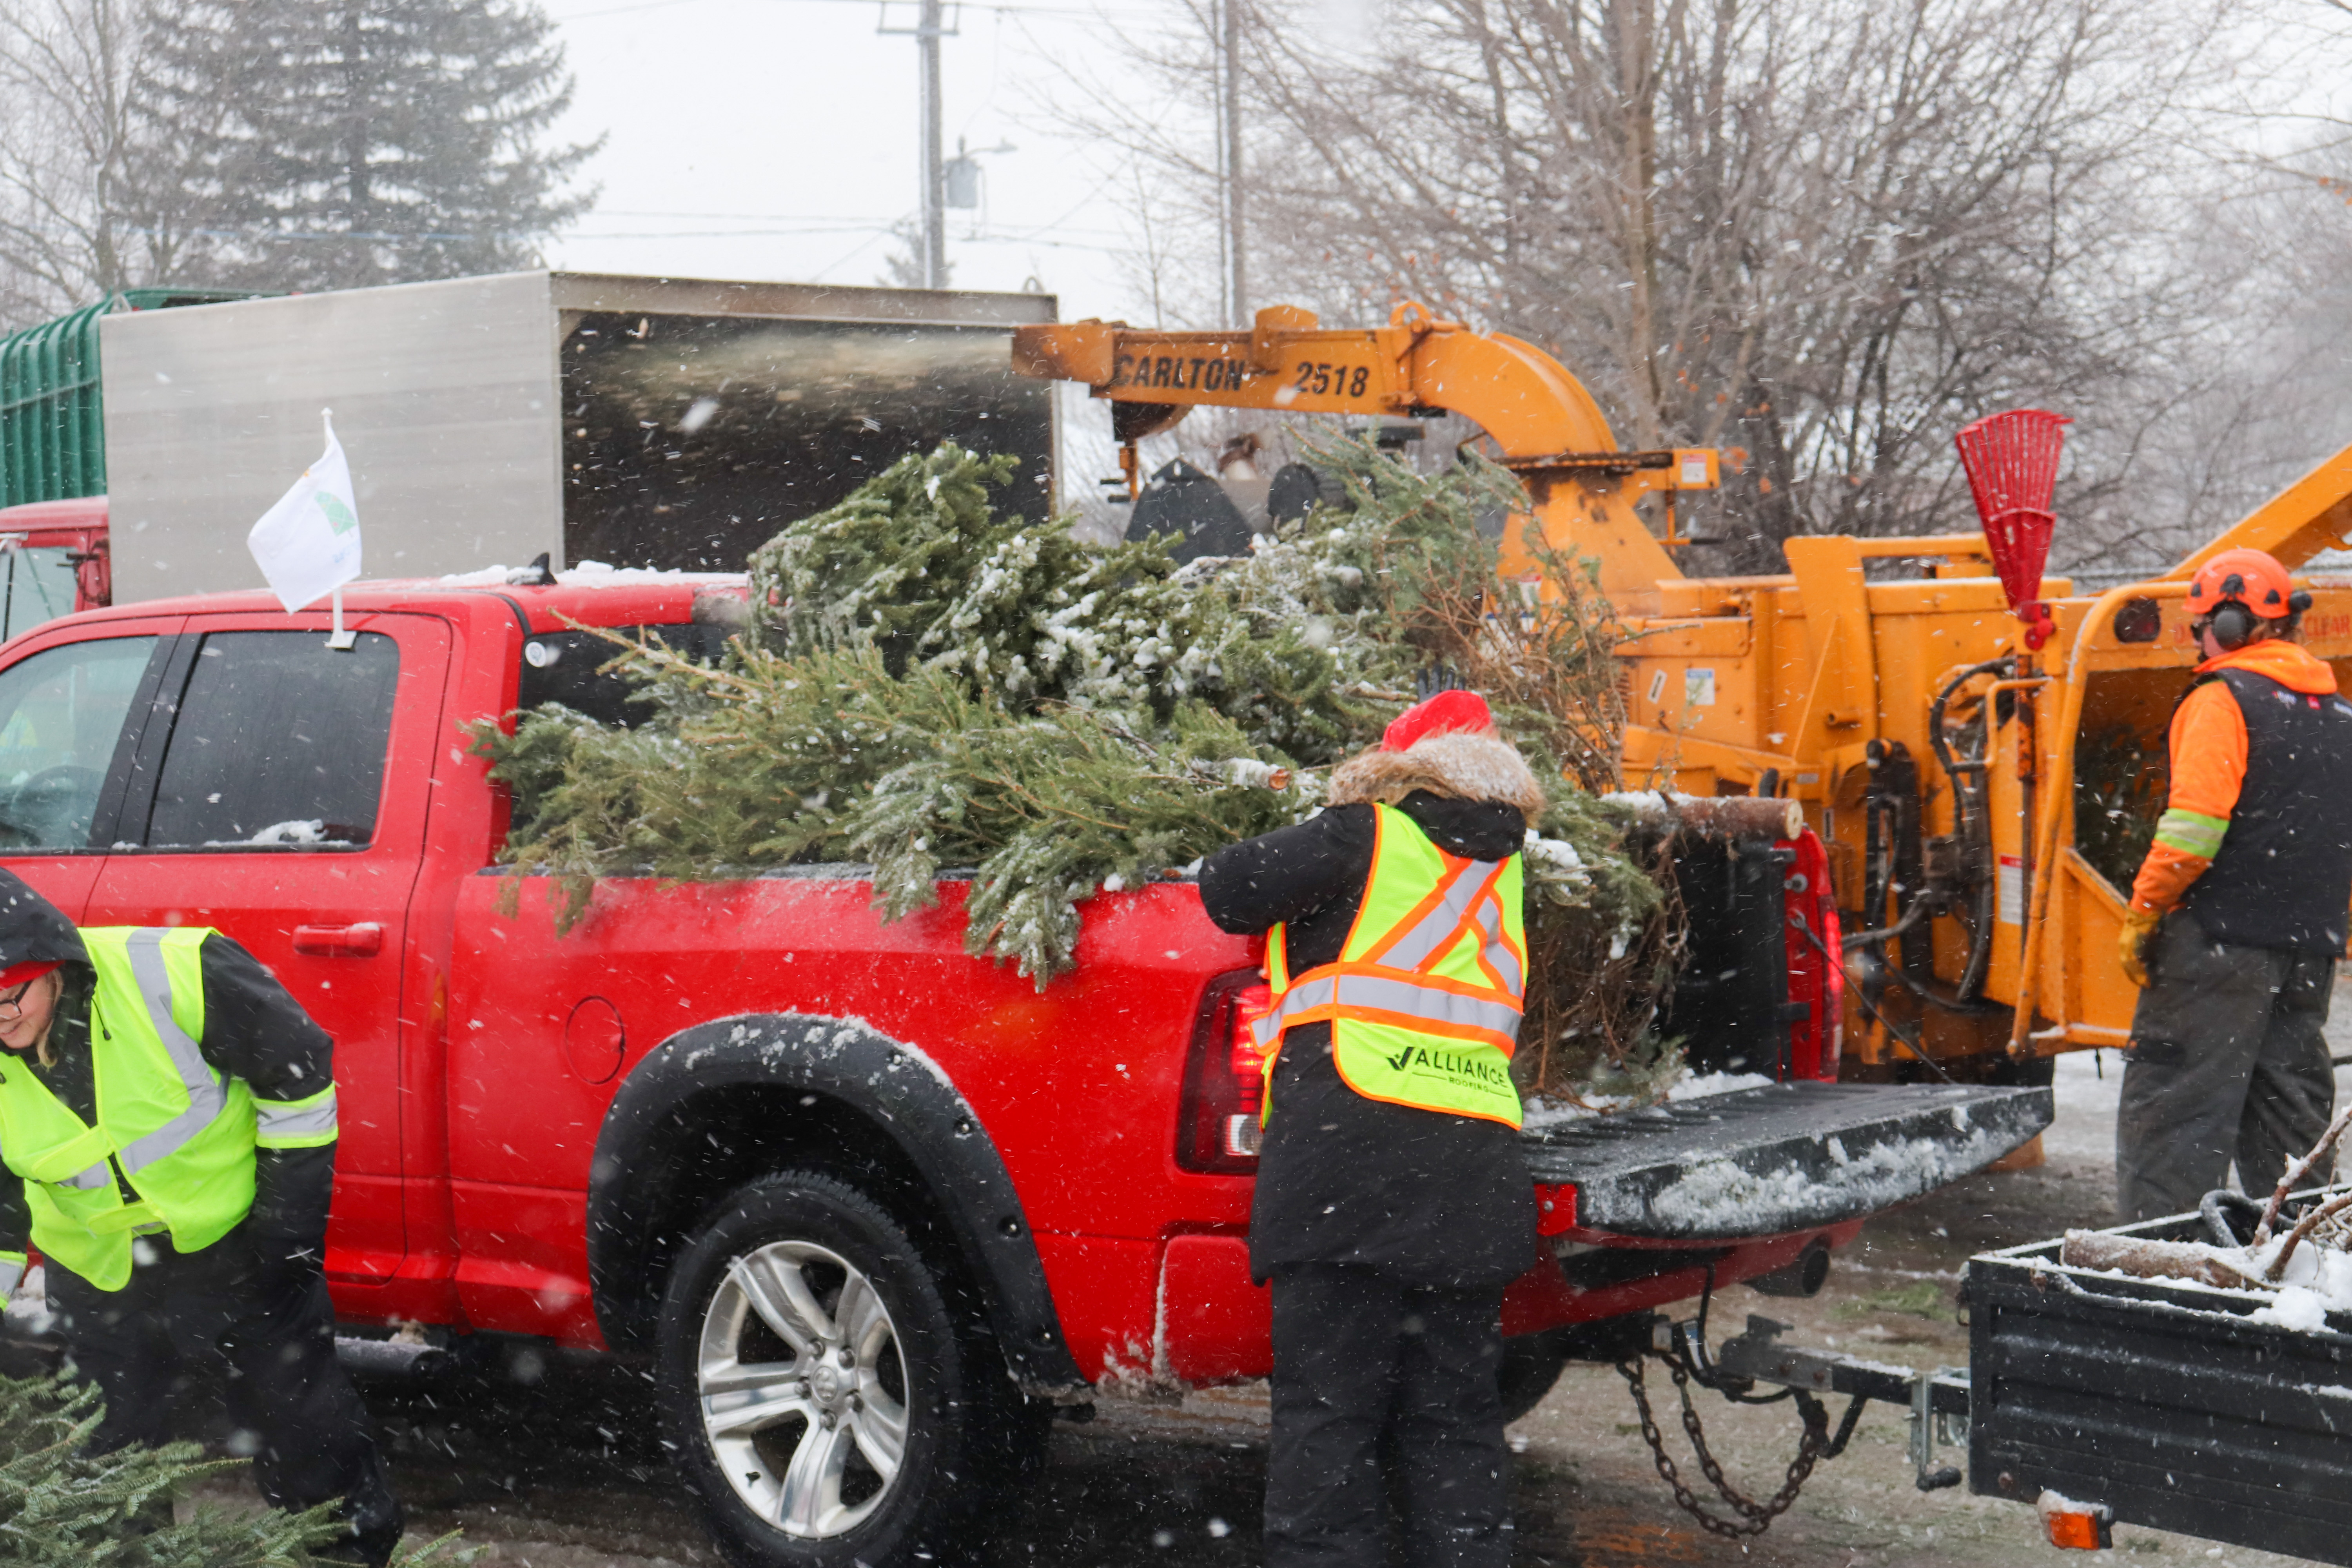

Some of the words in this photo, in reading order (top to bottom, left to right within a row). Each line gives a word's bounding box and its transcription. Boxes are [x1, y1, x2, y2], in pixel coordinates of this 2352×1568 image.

[1115, 354, 1245, 391] CARLTON
[1294, 361, 1369, 397] 2518
[1415, 1049, 1508, 1088] ALLIANCE
[1449, 1077, 1489, 1093] ROOFING
